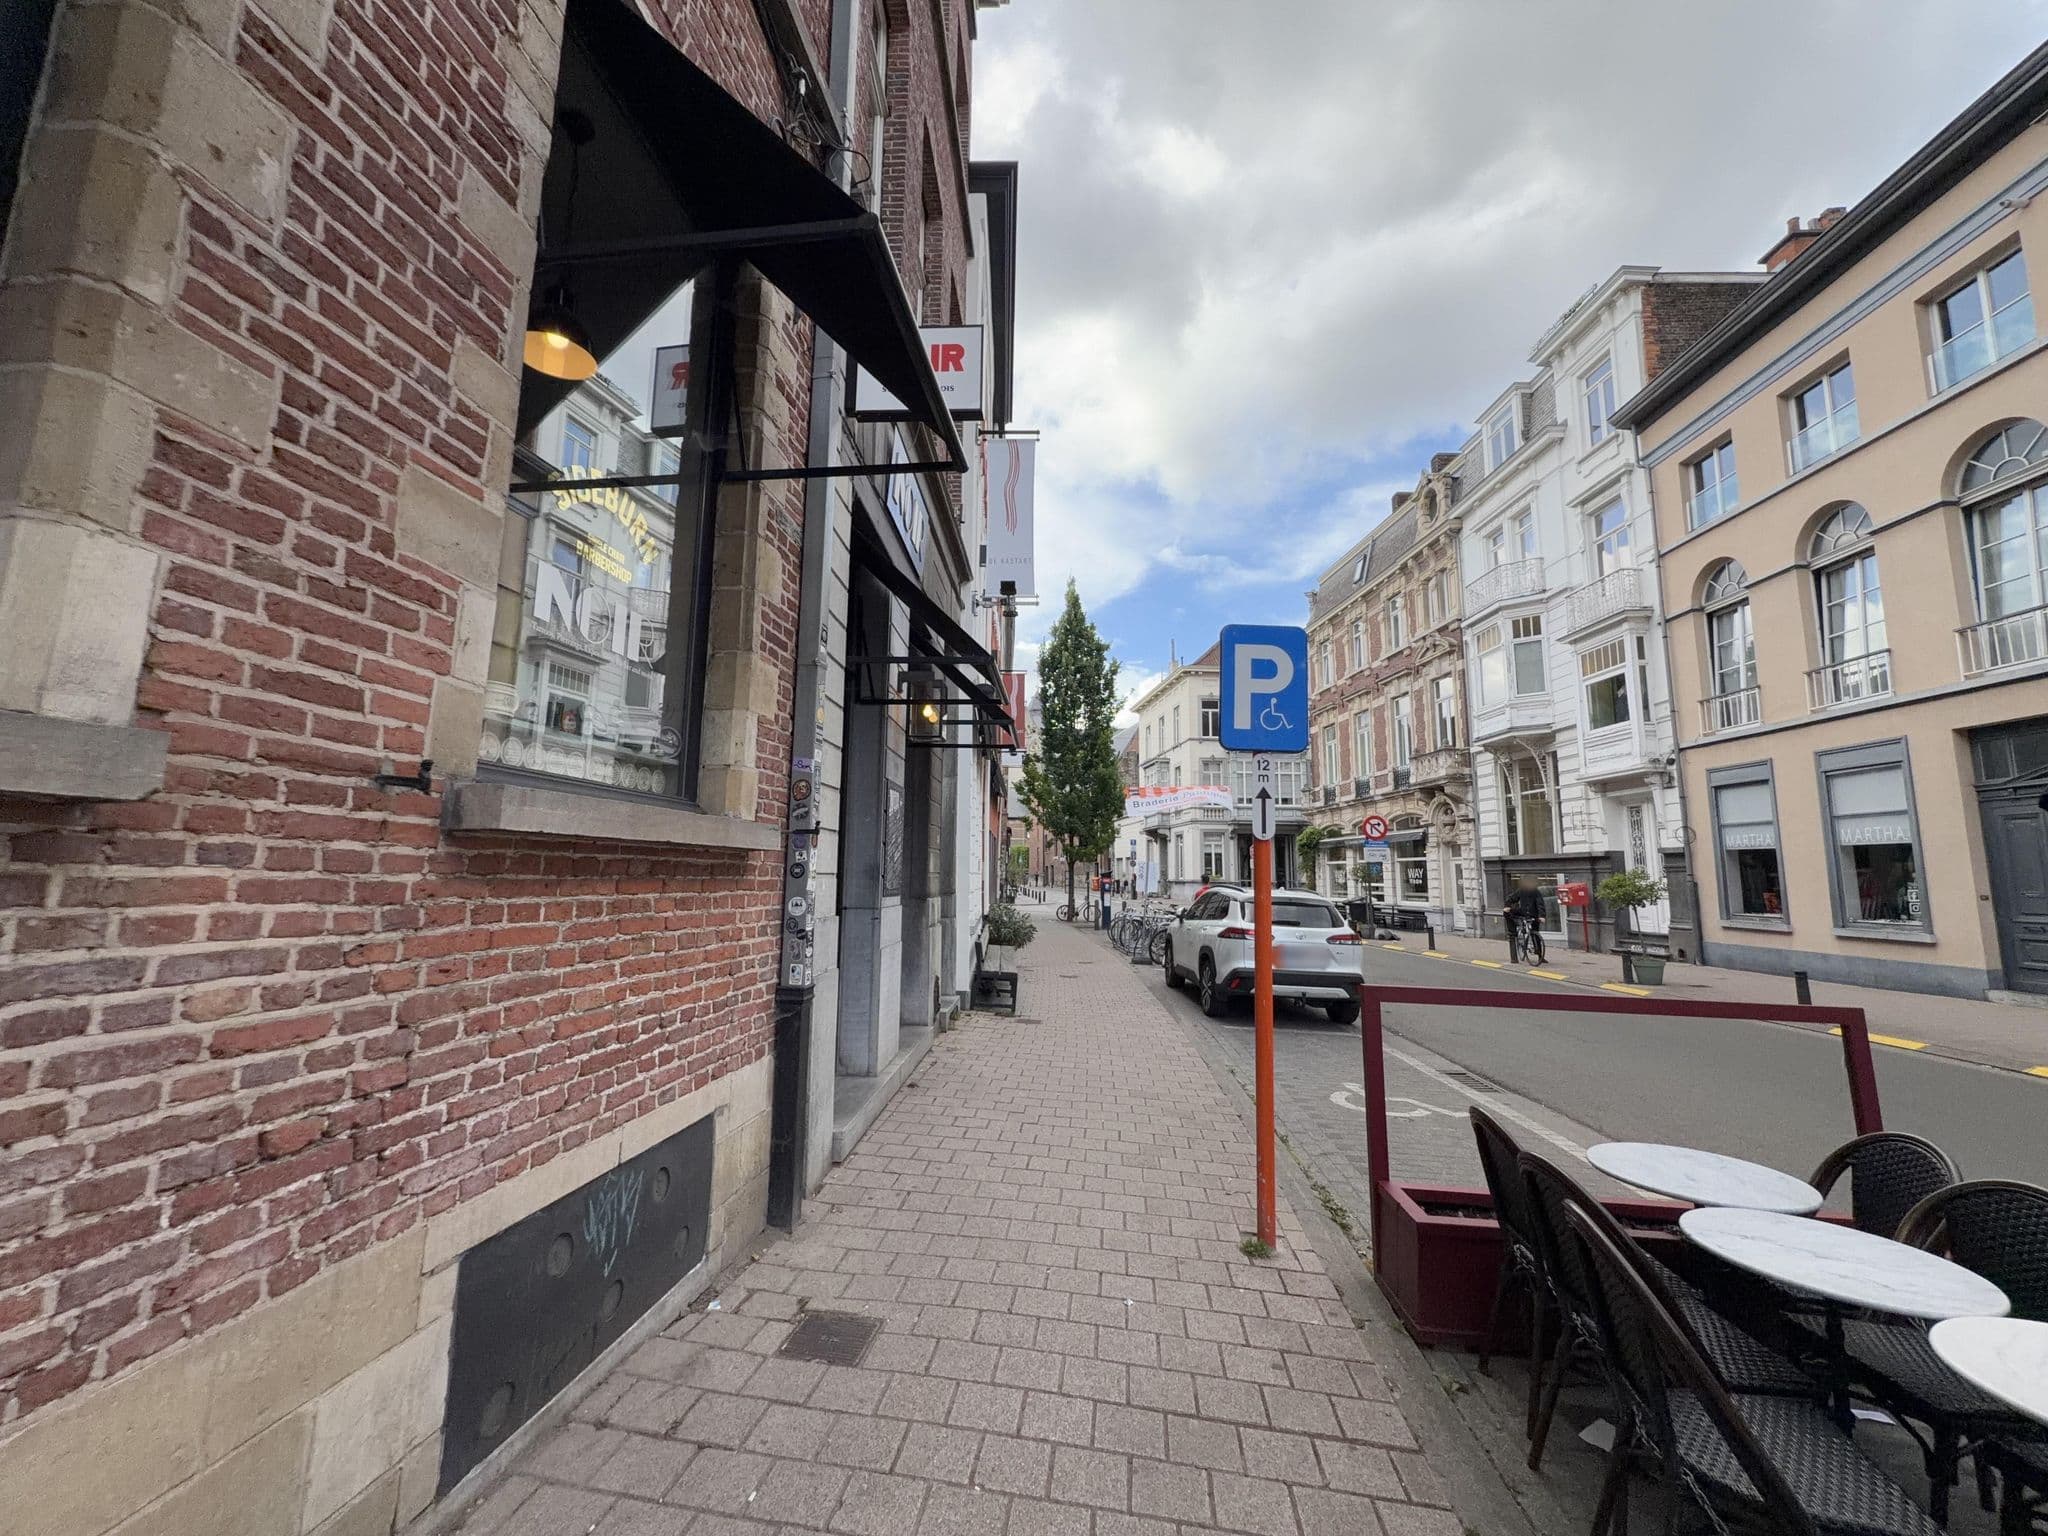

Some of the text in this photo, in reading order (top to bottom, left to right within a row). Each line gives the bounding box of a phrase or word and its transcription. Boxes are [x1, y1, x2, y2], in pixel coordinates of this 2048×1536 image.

[891, 451, 926, 563] NOIR
[576, 540, 632, 584] BARBERSHOP
[533, 559, 656, 670] NOIR
[1233, 643, 1294, 730] P
[1257, 759, 1271, 772] 12
[1258, 774, 1270, 783] m
[1407, 868, 1424, 879] WAY
